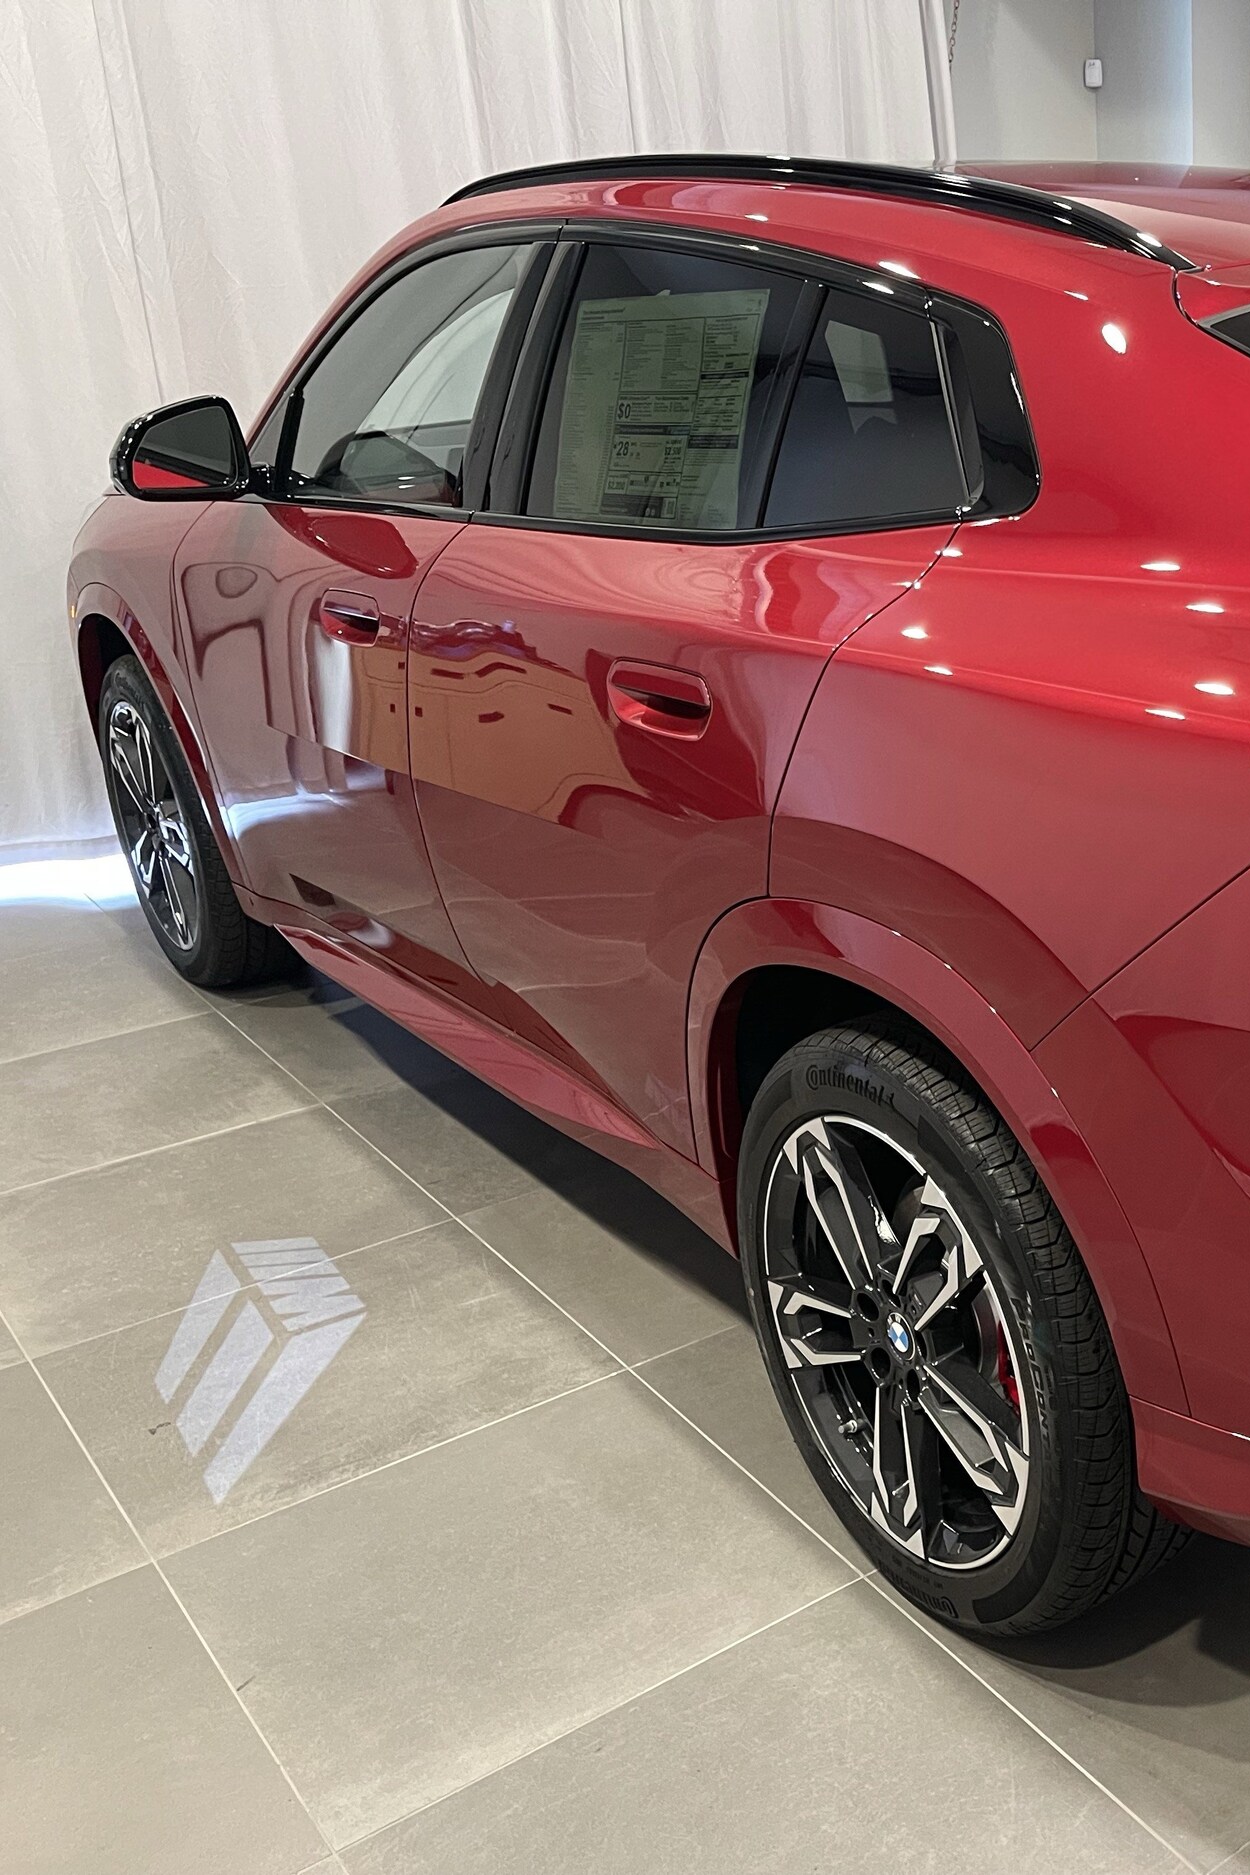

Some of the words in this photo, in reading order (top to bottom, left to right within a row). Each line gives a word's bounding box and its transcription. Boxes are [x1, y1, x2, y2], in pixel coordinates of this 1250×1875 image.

[617, 402, 631, 420] $0
[616, 441, 629, 456] 28
[805, 1064, 885, 1106] Continental
